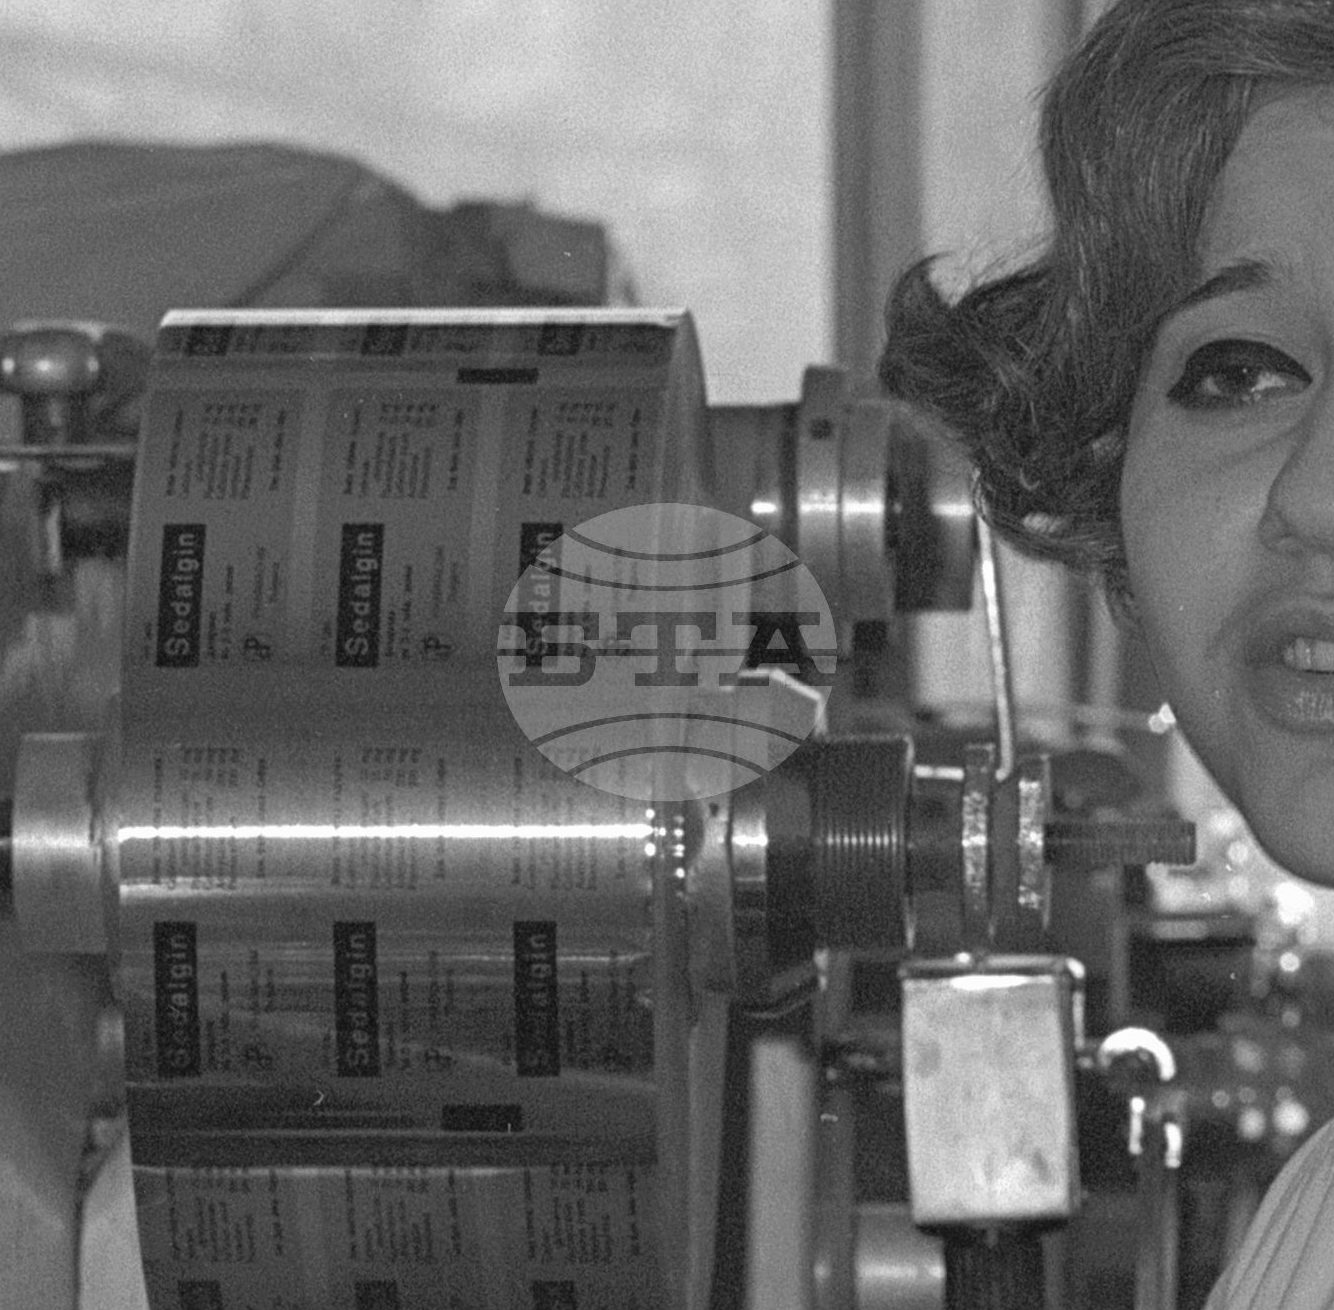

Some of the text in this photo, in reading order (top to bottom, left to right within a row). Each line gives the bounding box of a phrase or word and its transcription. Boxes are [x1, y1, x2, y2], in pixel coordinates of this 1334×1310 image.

[166, 532, 198, 657] Sedalgin
[345, 532, 378, 656] Sedalgin
[344, 934, 374, 1068] Sedalgin
